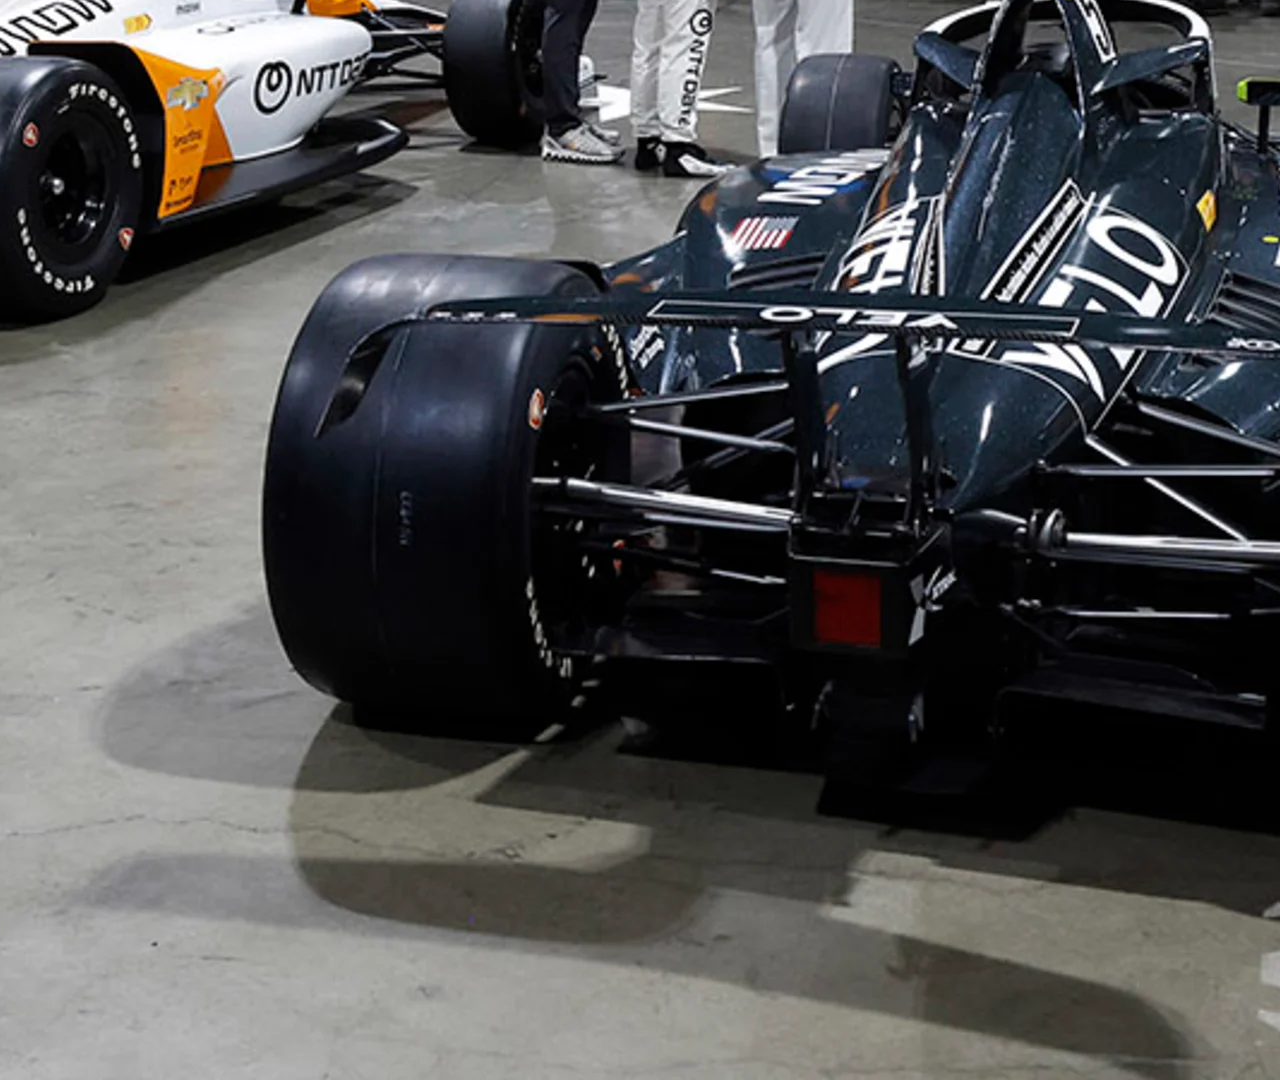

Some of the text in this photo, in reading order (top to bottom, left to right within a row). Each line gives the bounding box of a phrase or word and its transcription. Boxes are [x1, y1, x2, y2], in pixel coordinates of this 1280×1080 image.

[296, 62, 340, 97] NTT
[69, 82, 141, 169] Firestone
[18, 207, 95, 294] Firestone
[759, 304, 959, 330] VELO
